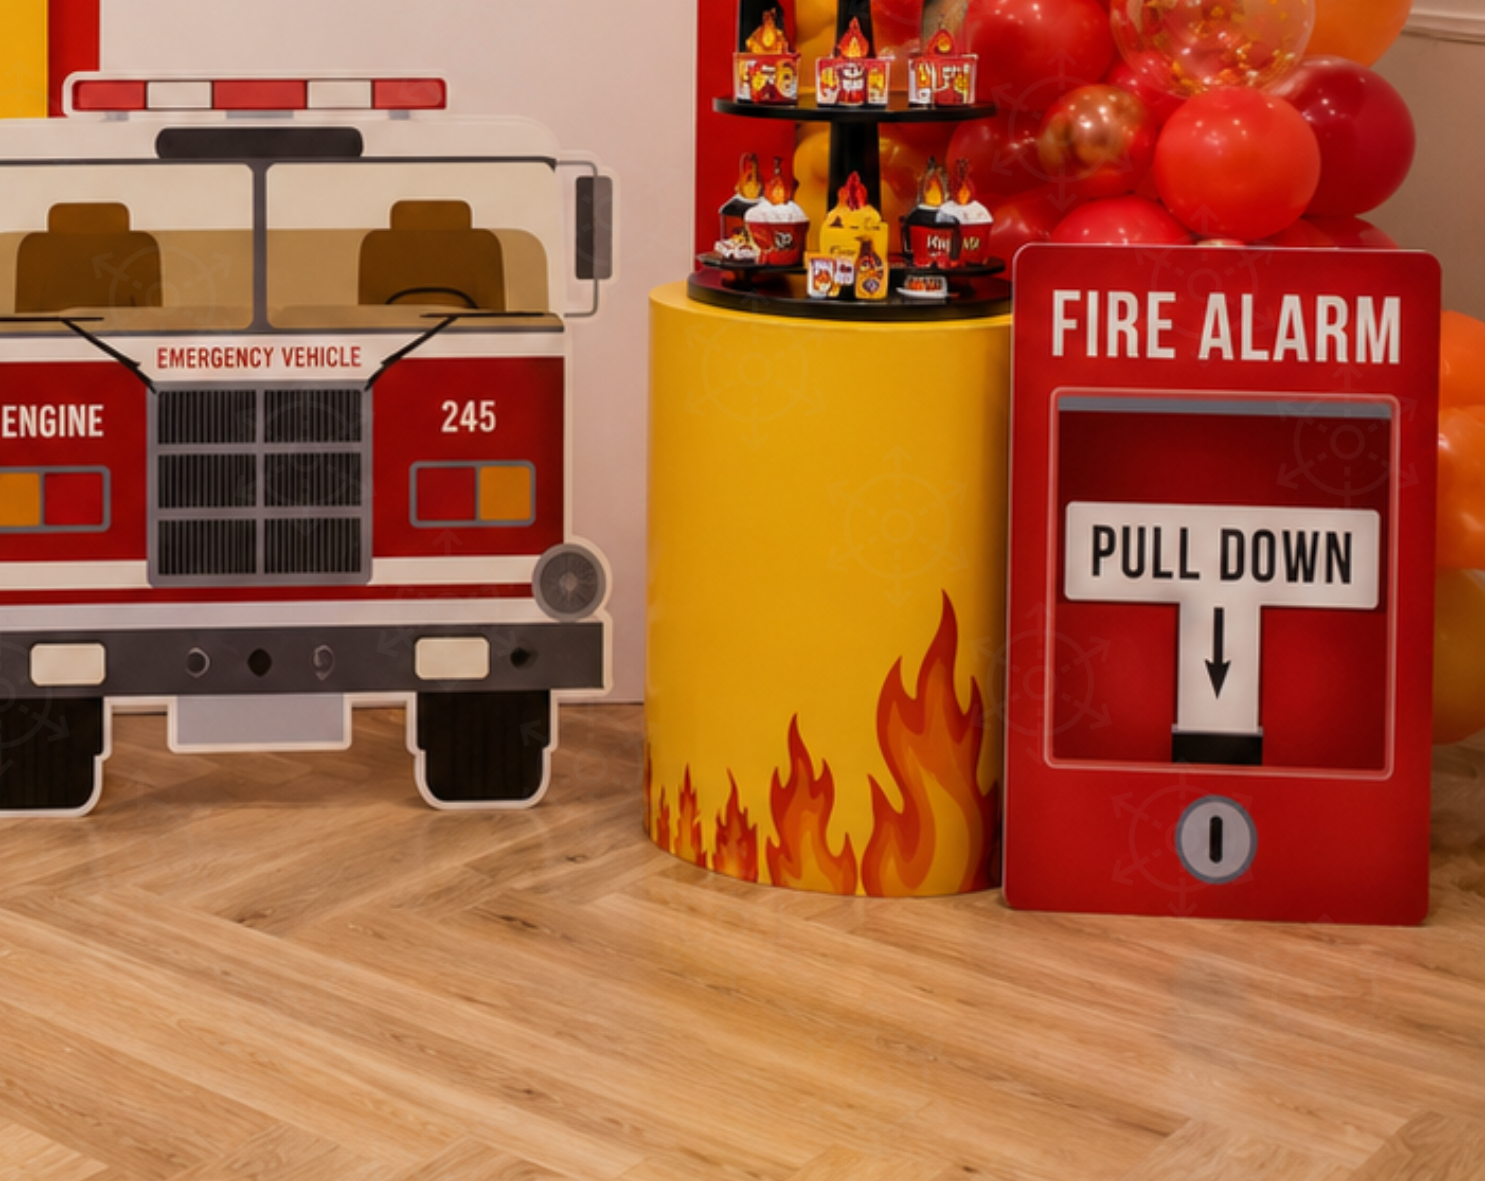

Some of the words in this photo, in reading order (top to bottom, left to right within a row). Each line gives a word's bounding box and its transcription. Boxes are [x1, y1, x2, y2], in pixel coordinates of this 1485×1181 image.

[1052, 289, 1176, 359] FIRE
[1198, 292, 1400, 364] ALARM
[157, 346, 274, 369] EMERGENCY
[281, 346, 361, 368] VEHICLE
[2, 404, 104, 438] ENGINE
[441, 400, 496, 433] 245
[1092, 524, 1200, 580] PULL
[1219, 528, 1352, 585] DOWN
